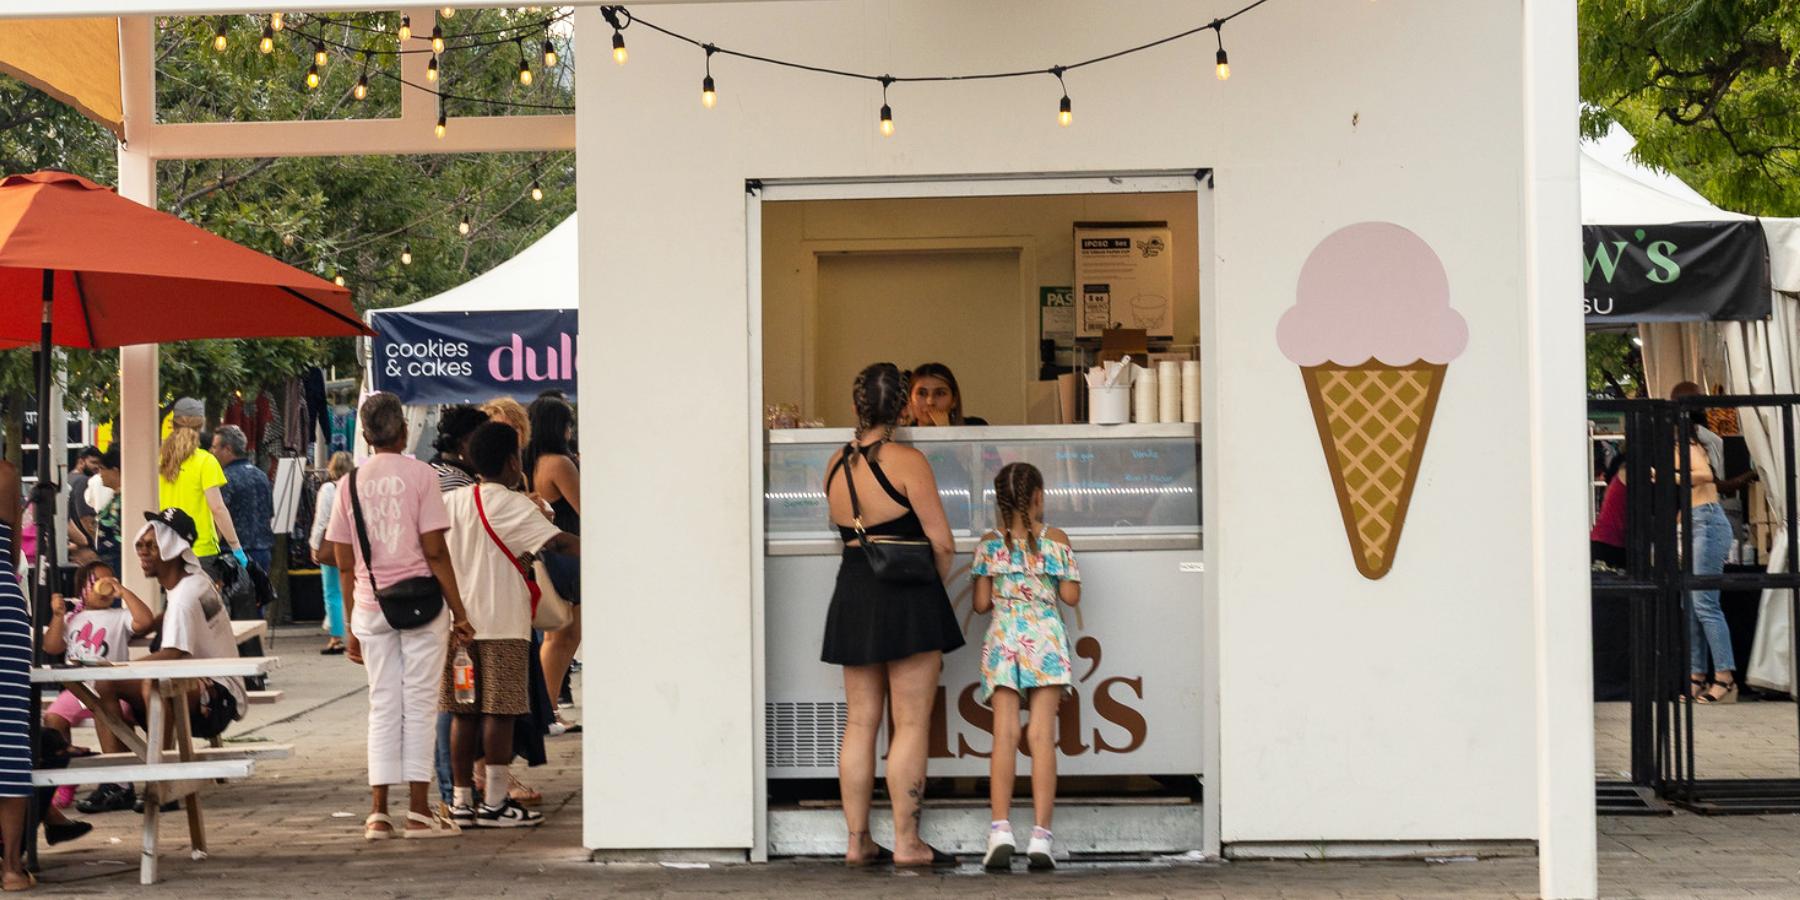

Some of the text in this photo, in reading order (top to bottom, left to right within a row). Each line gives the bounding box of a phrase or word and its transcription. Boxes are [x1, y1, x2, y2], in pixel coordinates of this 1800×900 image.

[385, 339, 469, 358] cookies
[488, 333, 577, 381] dul
[385, 358, 473, 377] & cakes
[363, 476, 406, 498] OOD
[370, 521, 407, 555] nly
[882, 636, 1147, 758] isa's
